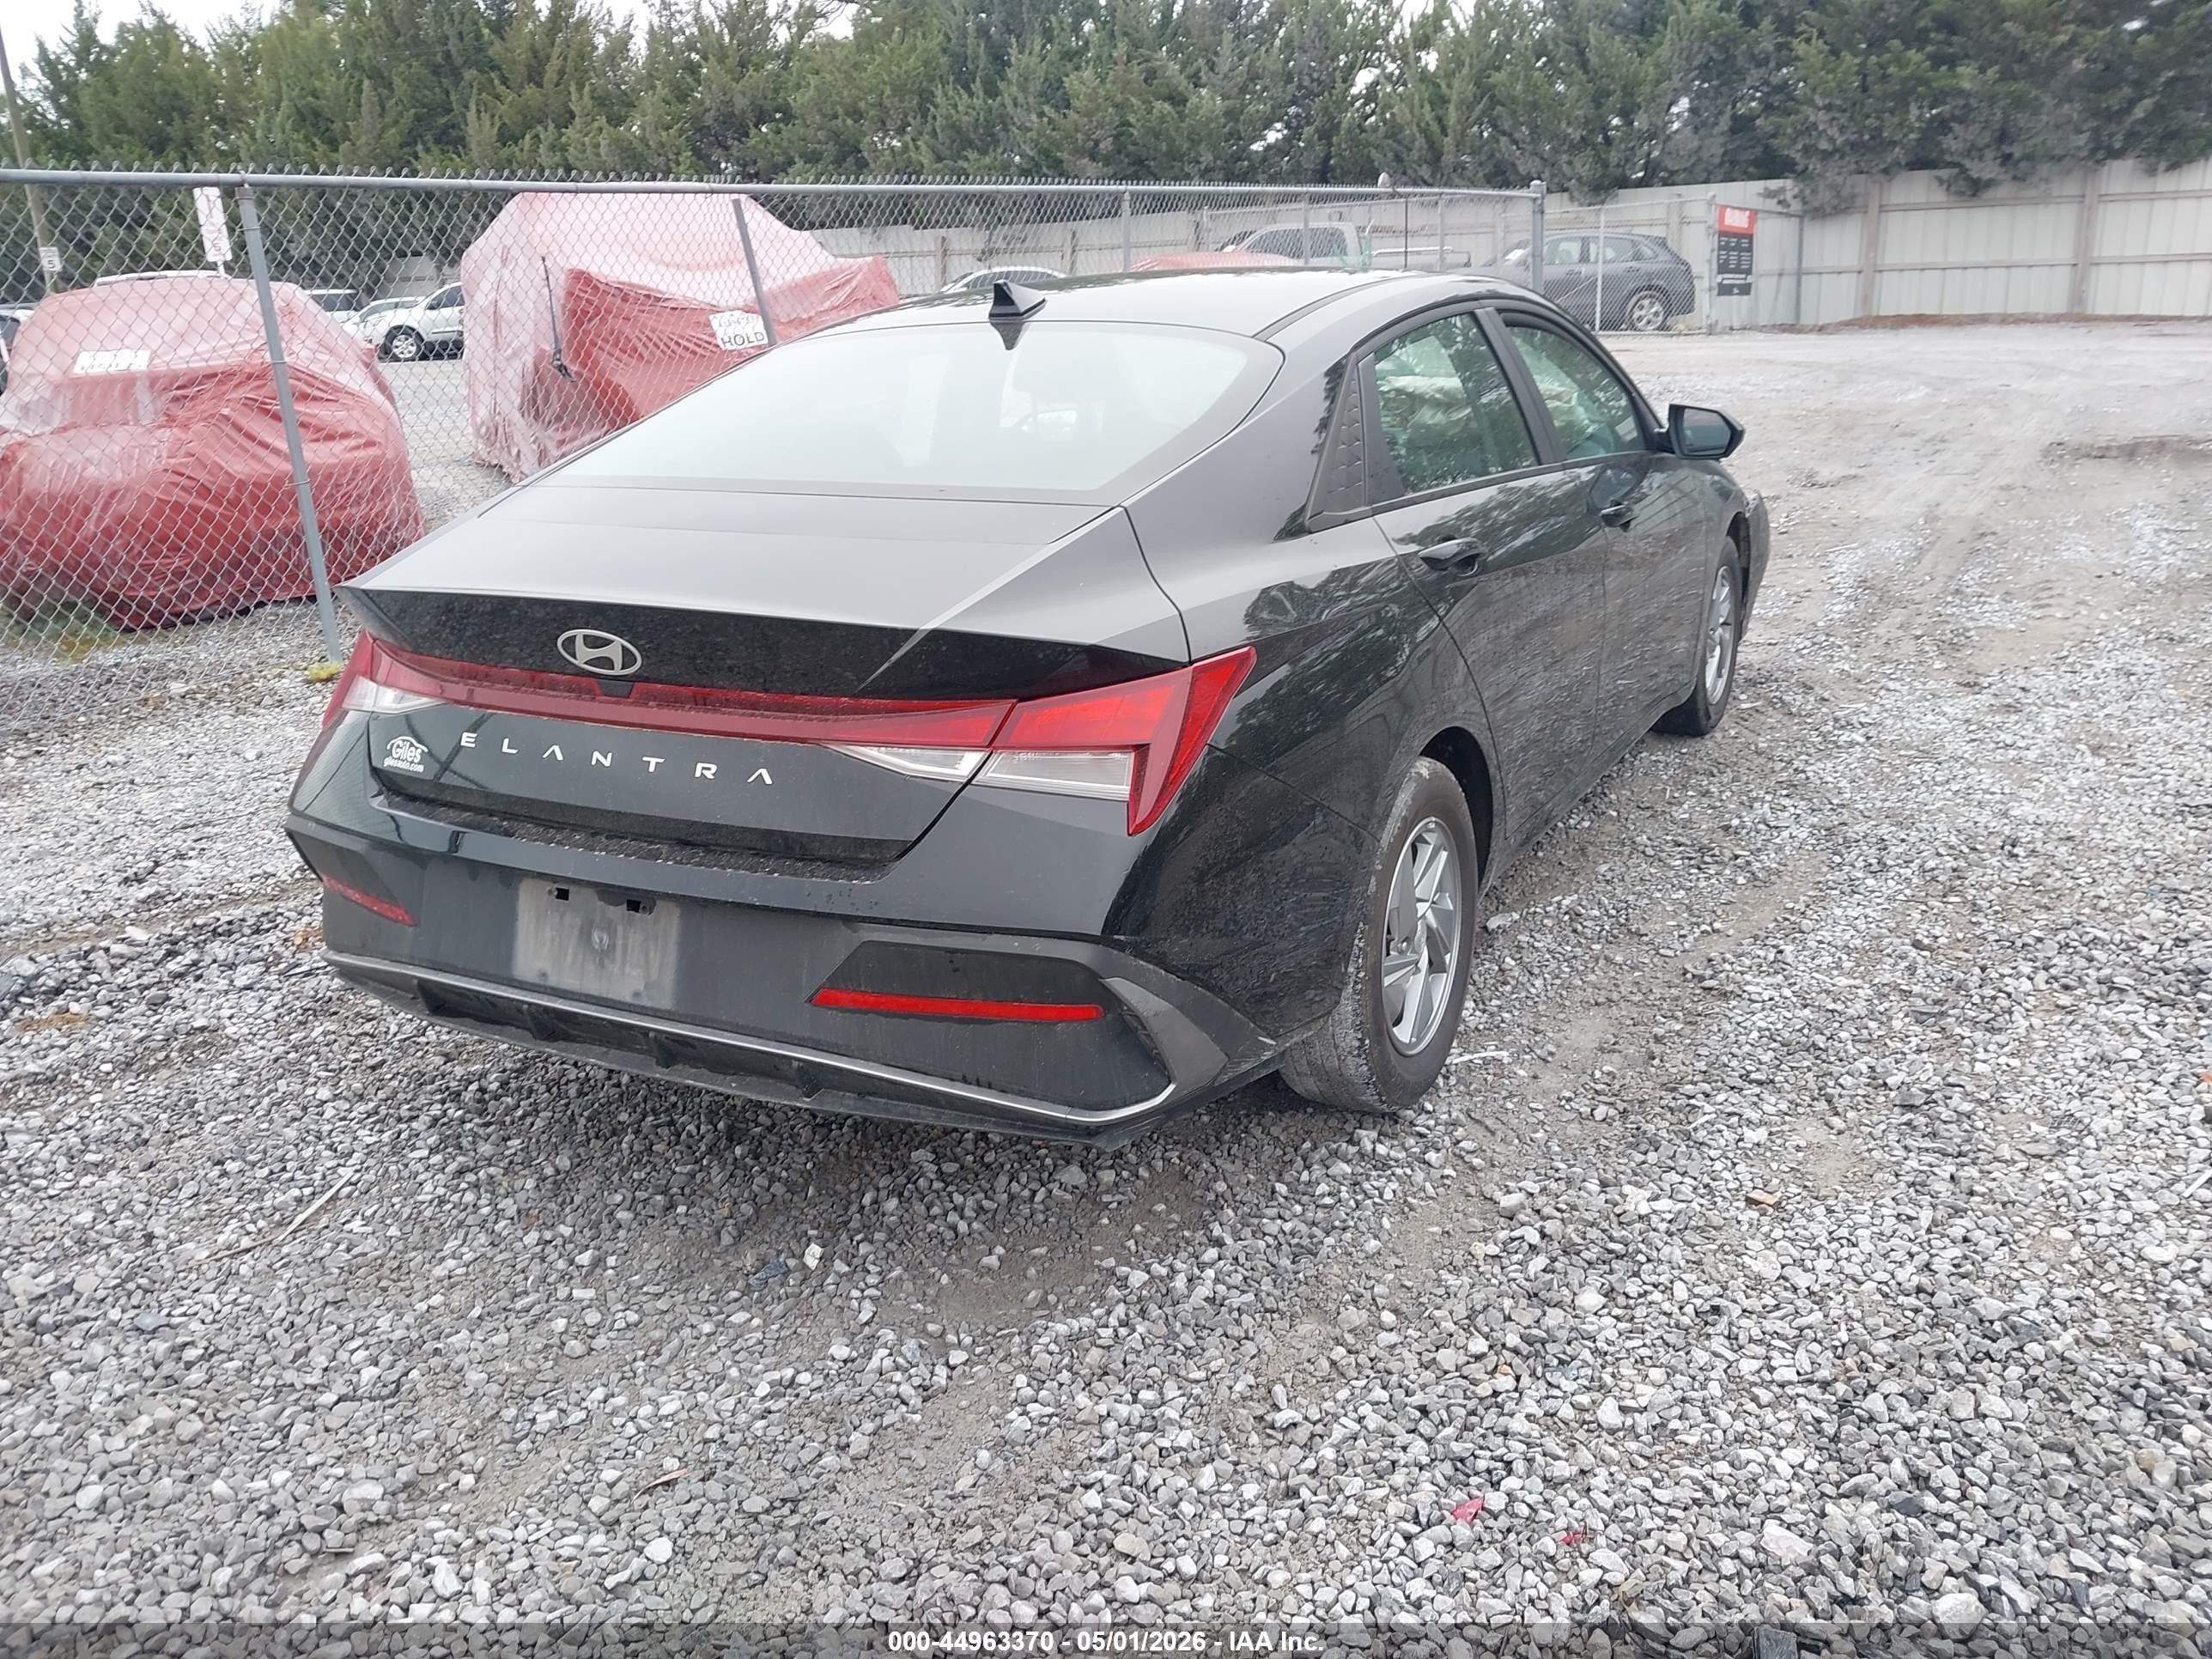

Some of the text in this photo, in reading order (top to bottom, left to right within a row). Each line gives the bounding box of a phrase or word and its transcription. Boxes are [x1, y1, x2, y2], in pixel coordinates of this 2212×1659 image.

[721, 331, 765, 347] HOLD
[392, 739, 422, 763] Giles
[459, 732, 774, 785] ELANTRA
